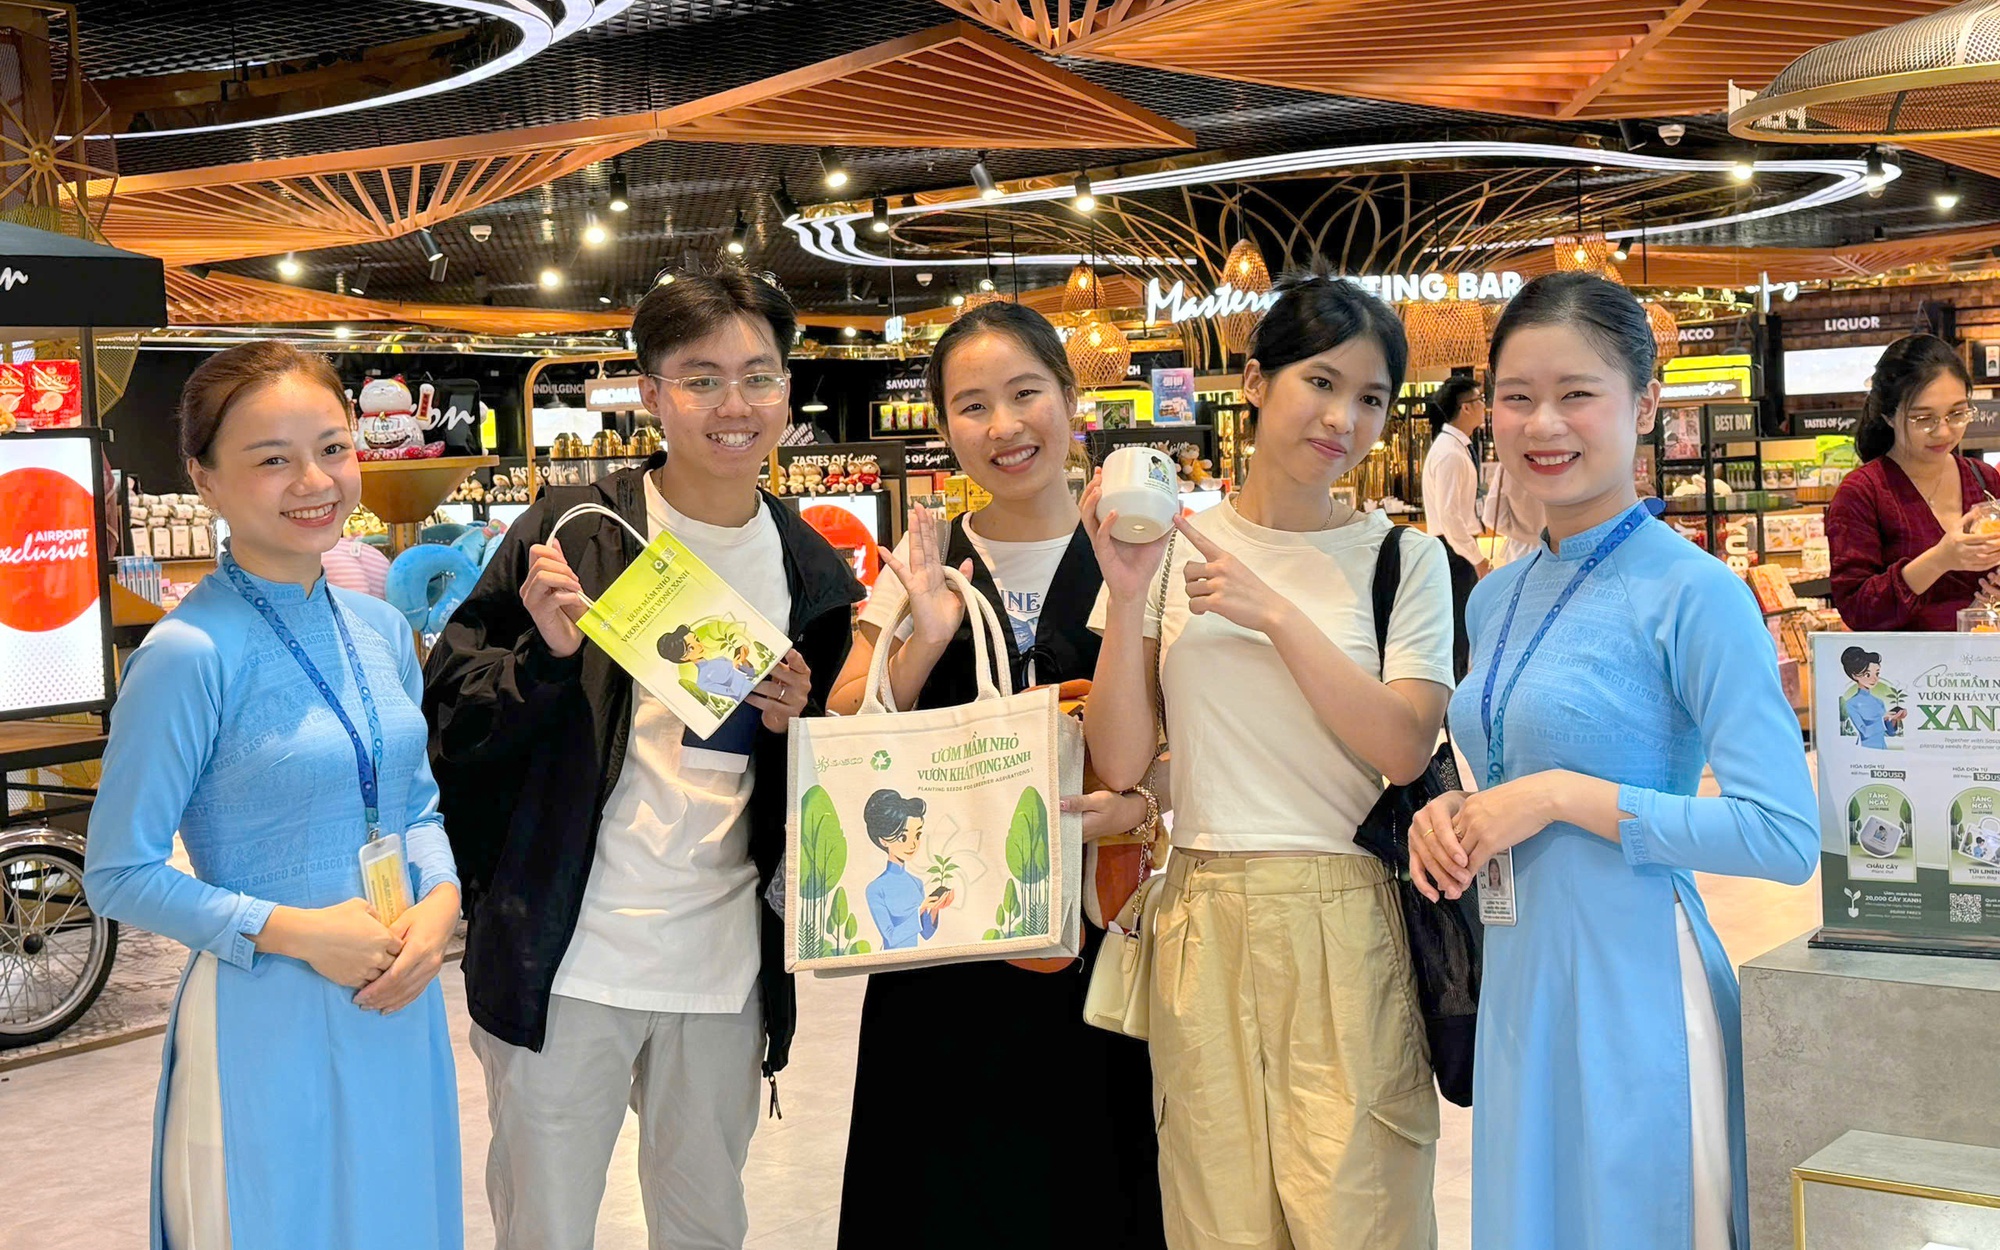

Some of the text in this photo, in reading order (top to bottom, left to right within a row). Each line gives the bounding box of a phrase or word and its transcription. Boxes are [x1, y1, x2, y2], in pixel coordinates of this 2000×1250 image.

[1458, 271, 1512, 300] BAR
[1824, 316, 1880, 331] LIQUOR
[1714, 414, 1752, 432] BEST BUY
[1803, 418, 1827, 429] TASTES
[1828, 417, 1838, 428] OF
[792, 455, 830, 467] TASTES
[911, 455, 924, 464] OF
[35, 528, 89, 542] AIRPORT
[1926, 673, 1958, 688] ƯƠM
[1960, 675, 1989, 688] MẦM
[1918, 691, 1951, 701] VƯƠN
[1917, 704, 2000, 732] XAN
[931, 731, 1019, 764] ƯƠM MẦM NHỎ
[917, 767, 948, 782] VƯƠN
[1002, 751, 1031, 770] XANH
